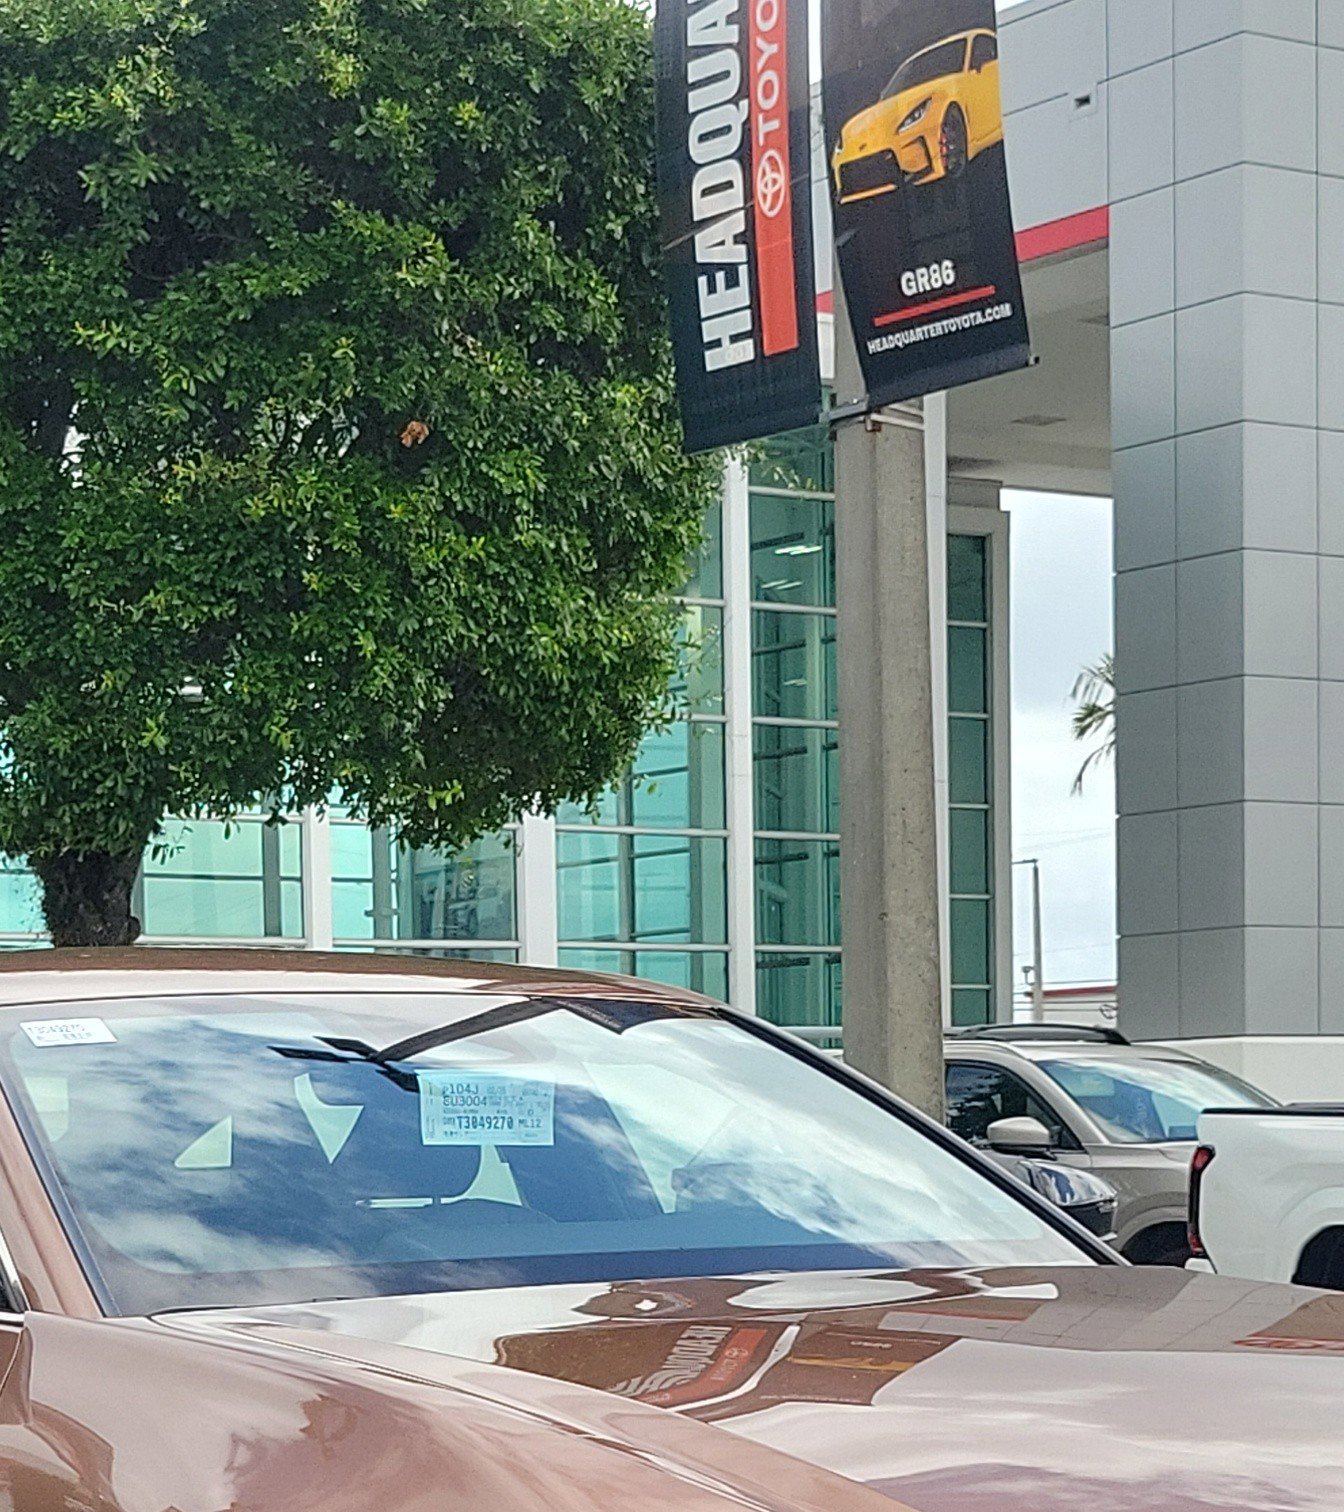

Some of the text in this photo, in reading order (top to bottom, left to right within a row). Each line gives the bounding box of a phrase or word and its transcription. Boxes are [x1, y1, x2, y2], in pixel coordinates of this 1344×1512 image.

[687, 0, 755, 372] HEADQUA
[901, 259, 955, 296] GR86
[867, 302, 1013, 355] HEADQUARTERTOYOTA.COM
